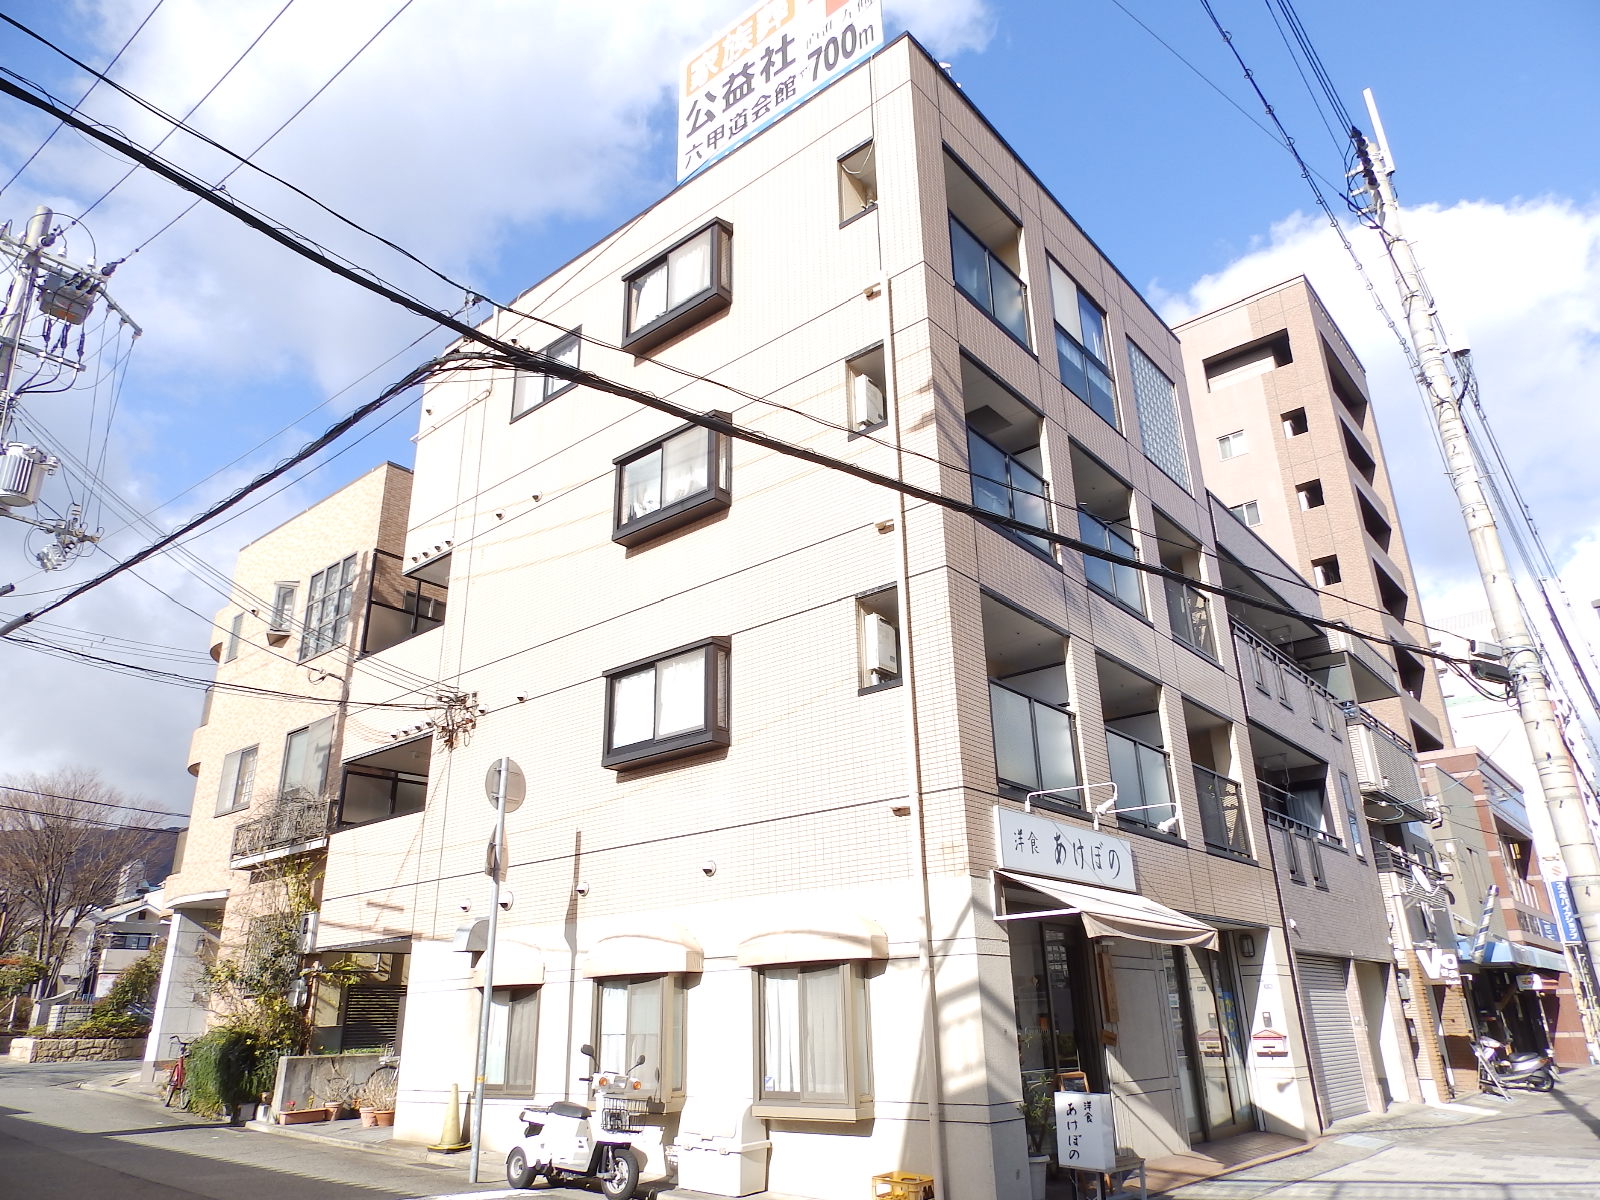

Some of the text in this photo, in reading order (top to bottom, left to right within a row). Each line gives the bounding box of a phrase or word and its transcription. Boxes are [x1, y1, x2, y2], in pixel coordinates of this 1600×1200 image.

[685, 75, 797, 169] 六甲道会館
[808, 24, 874, 82] 700m
[686, 34, 796, 138] 公益社
[1014, 829, 1121, 880] 洋食 あけぼの
[1066, 1102, 1082, 1160] あけぼの
[1083, 1100, 1093, 1124] 洋食
